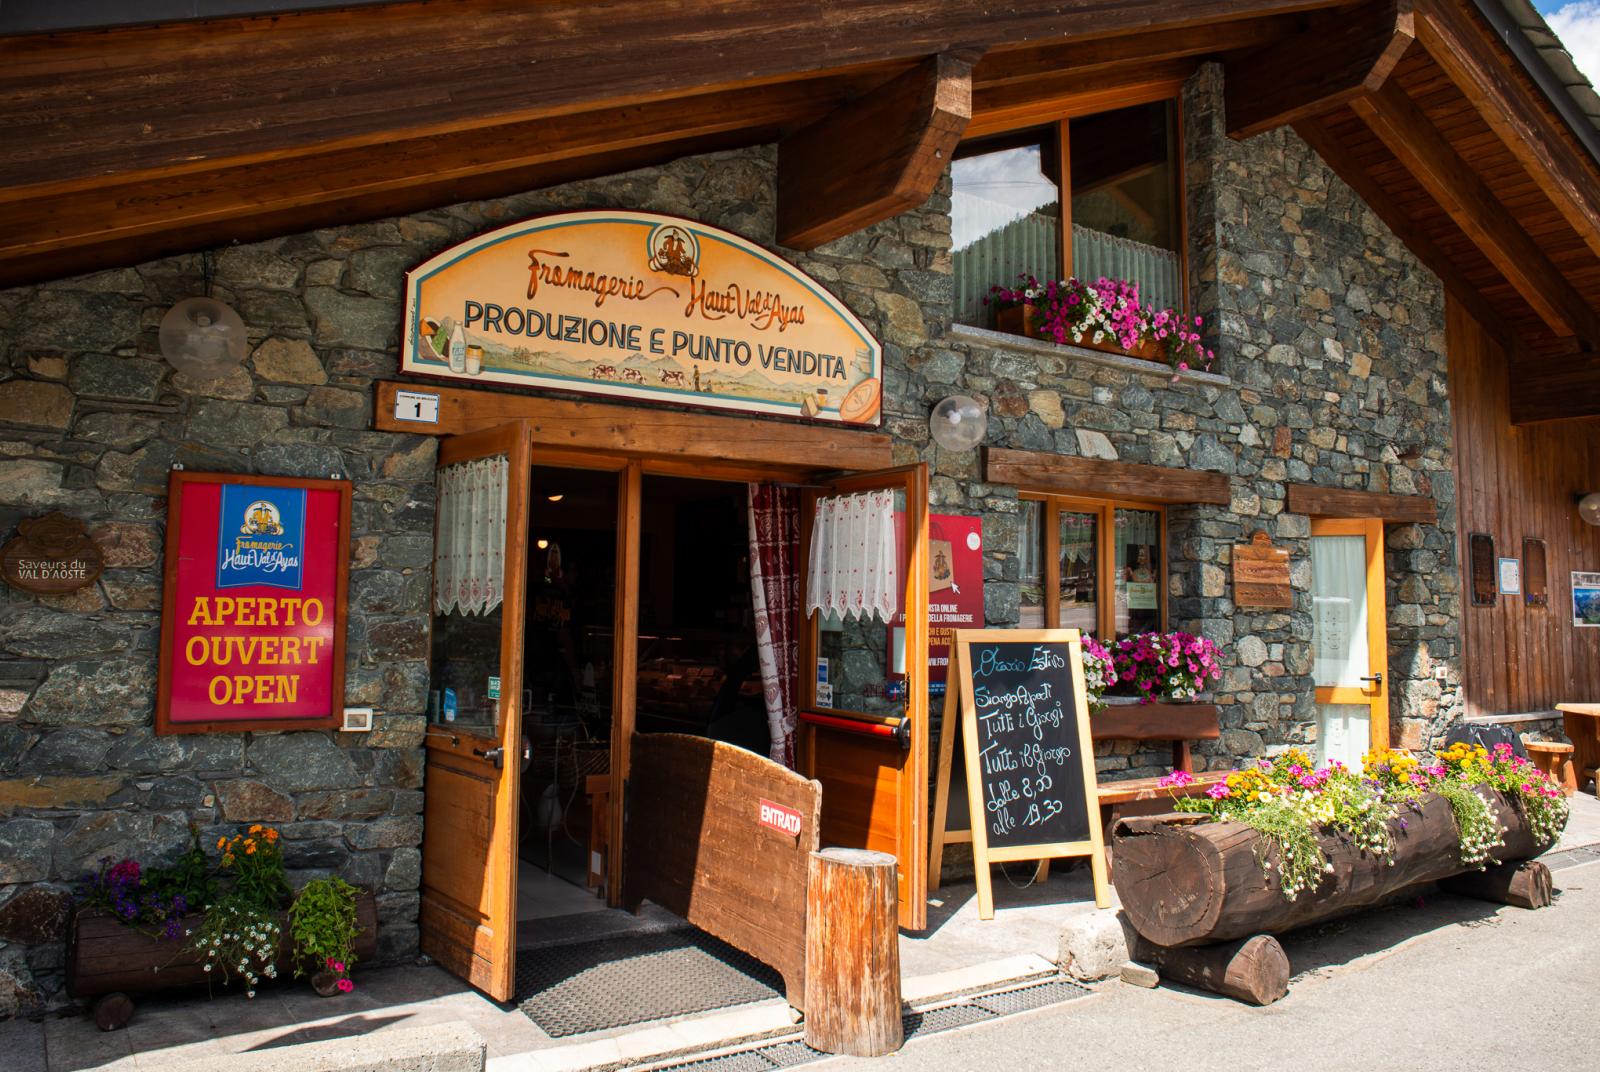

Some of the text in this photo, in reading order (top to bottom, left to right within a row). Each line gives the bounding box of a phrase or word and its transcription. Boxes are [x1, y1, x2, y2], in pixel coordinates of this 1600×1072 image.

[527, 249, 680, 308] Fromagerie
[685, 277, 735, 320] Haut
[728, 283, 764, 319] Val
[464, 300, 847, 380] PRODUZIONE E PUNTO VENDITA
[414, 402, 421, 418] 1
[236, 536, 294, 556] Fromagerie
[18, 558, 86, 569] Saveurs du
[221, 548, 254, 570] Haut
[248, 549, 273, 568] Val
[18, 568, 86, 579] VAL D'AOSTE
[187, 596, 324, 627] APERTO
[941, 604, 958, 613] ONLINE
[943, 613, 973, 623] FROMAGERIE
[185, 636, 324, 666] OUVERT
[208, 675, 300, 705] OPEN
[1019, 713, 1025, 728] i
[761, 804, 801, 834] ENTRATA
[993, 807, 1016, 835] alle
